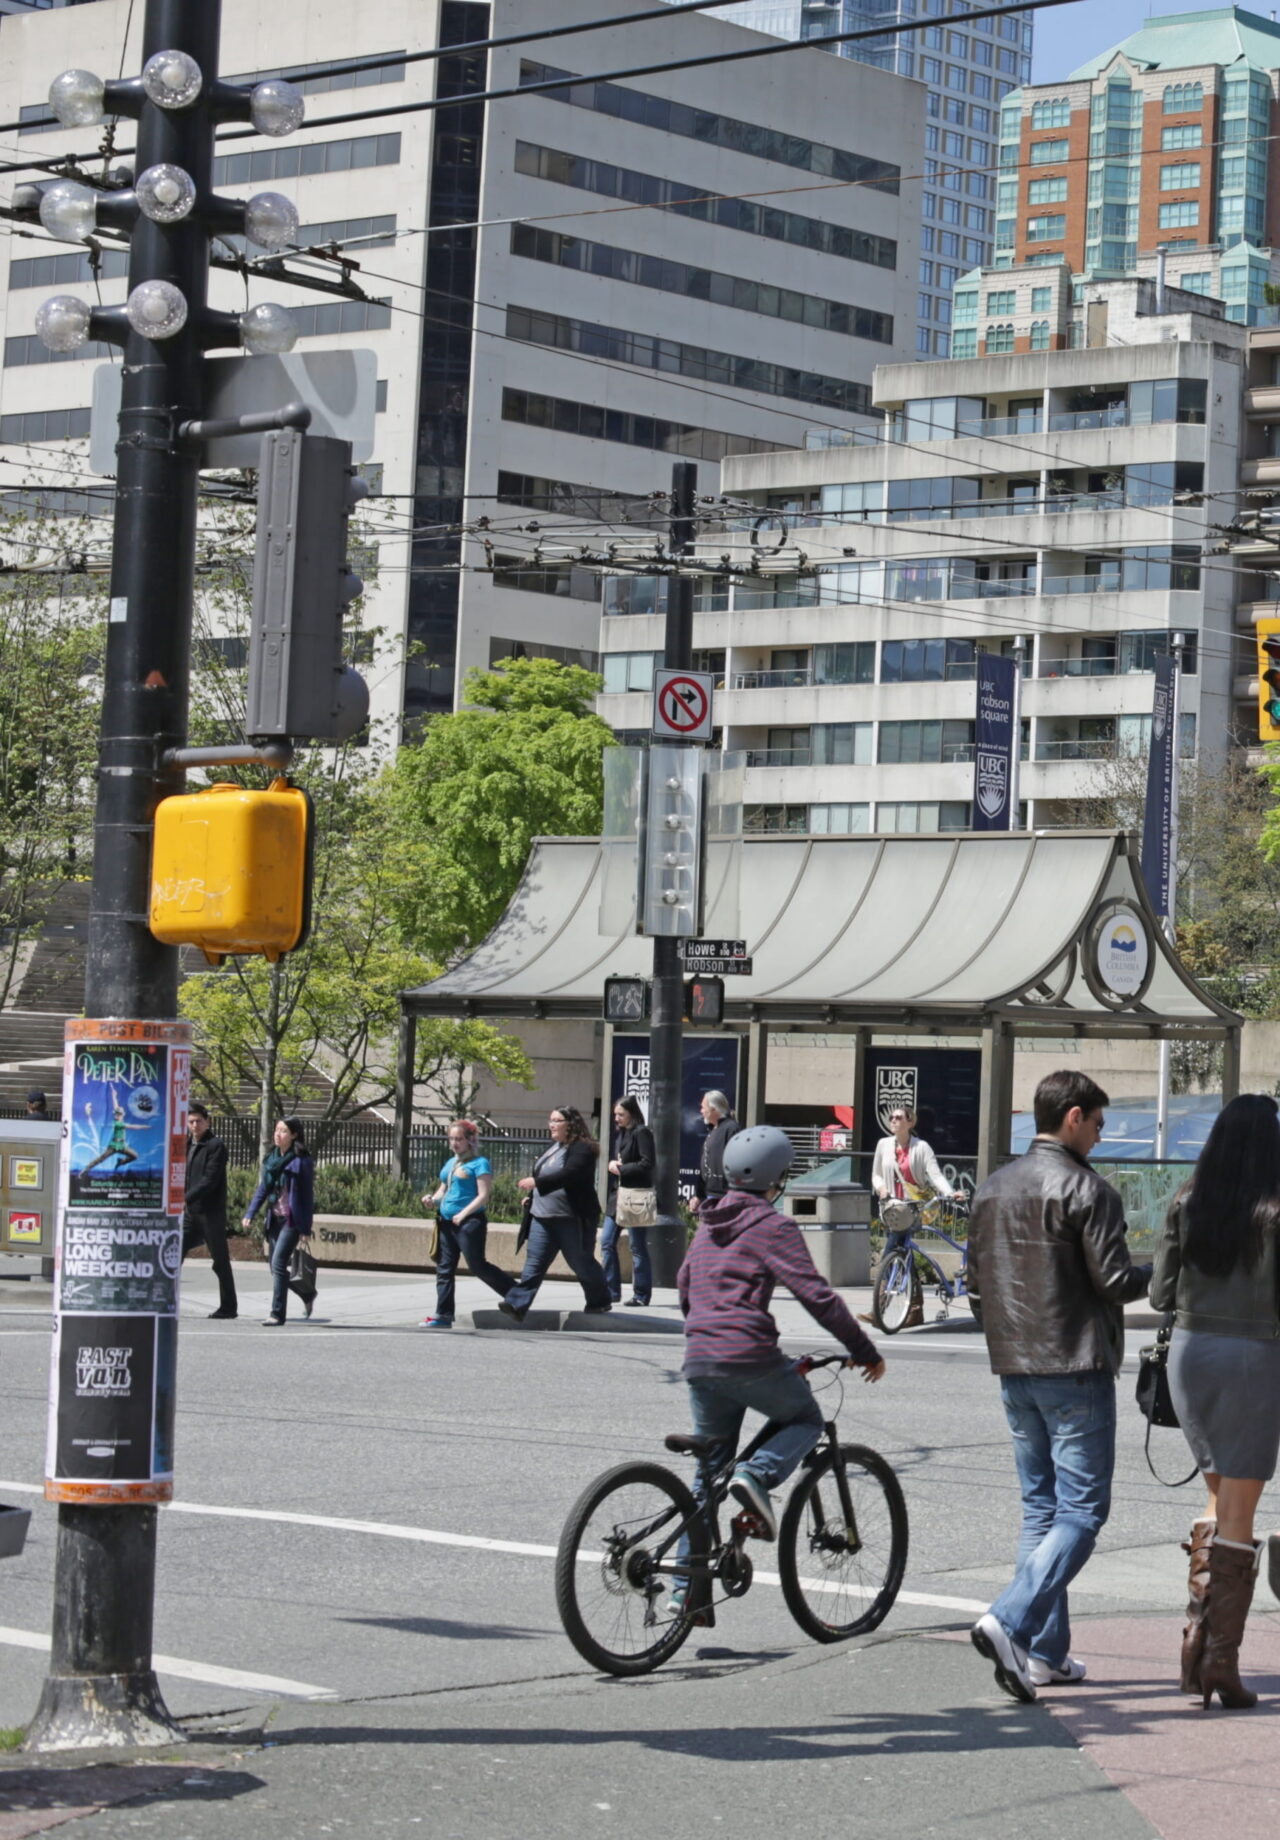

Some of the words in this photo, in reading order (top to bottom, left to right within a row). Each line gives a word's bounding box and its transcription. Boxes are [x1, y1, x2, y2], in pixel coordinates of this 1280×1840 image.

[980, 680, 995, 692] UBC
[980, 695, 1010, 710] robson
[980, 710, 1009, 724] square
[980, 756, 1005, 774] UBC
[1161, 807, 1169, 879] UNIVERSITY
[688, 942, 716, 956] Howe
[686, 960, 725, 972] Robson
[77, 1053, 134, 1088] PETER
[130, 1052, 159, 1085] PAN
[628, 1060, 650, 1078] UB
[879, 1070, 915, 1088] UBC
[65, 1227, 169, 1245] LEGENDARY
[320, 1227, 356, 1245] Square
[65, 1244, 112, 1260] LONG
[64, 1260, 154, 1278] WEEKEND
[76, 1347, 133, 1367] EAST
[76, 1366, 132, 1388] van
